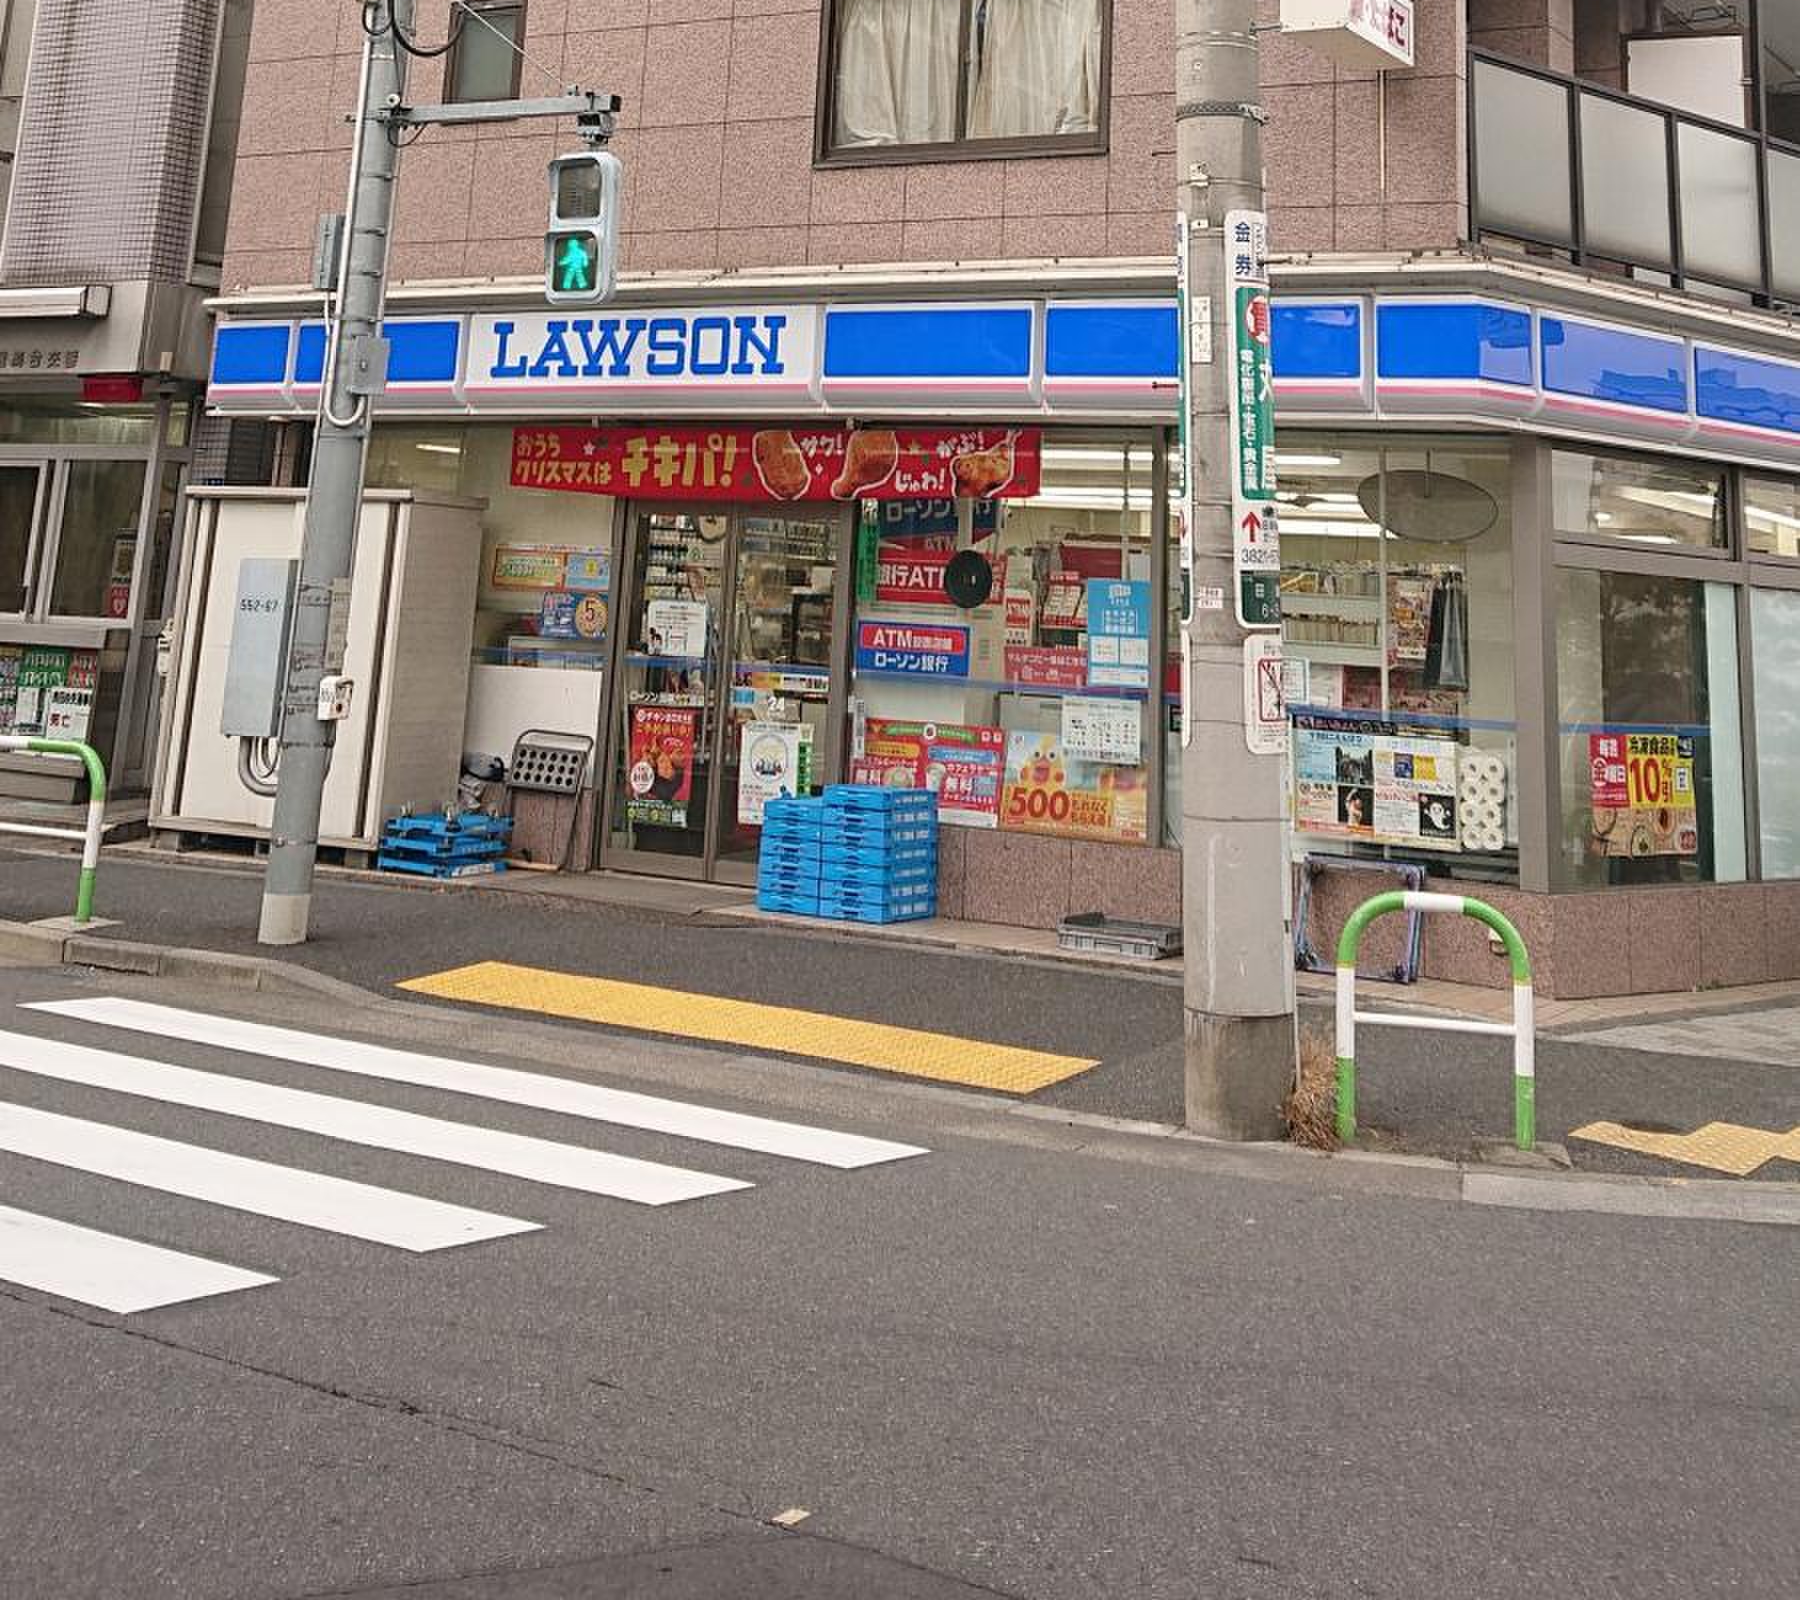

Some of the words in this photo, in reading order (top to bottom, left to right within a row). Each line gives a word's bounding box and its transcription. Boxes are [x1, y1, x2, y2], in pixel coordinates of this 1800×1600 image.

[490, 315, 786, 378] LAWSON
[516, 433, 561, 458] おうち
[516, 460, 613, 484] クリスマスは
[585, 600, 596, 619] 5
[874, 652, 950, 673] ローソン銀行
[1630, 757, 1661, 802] 10
[1007, 787, 1071, 821] 500
